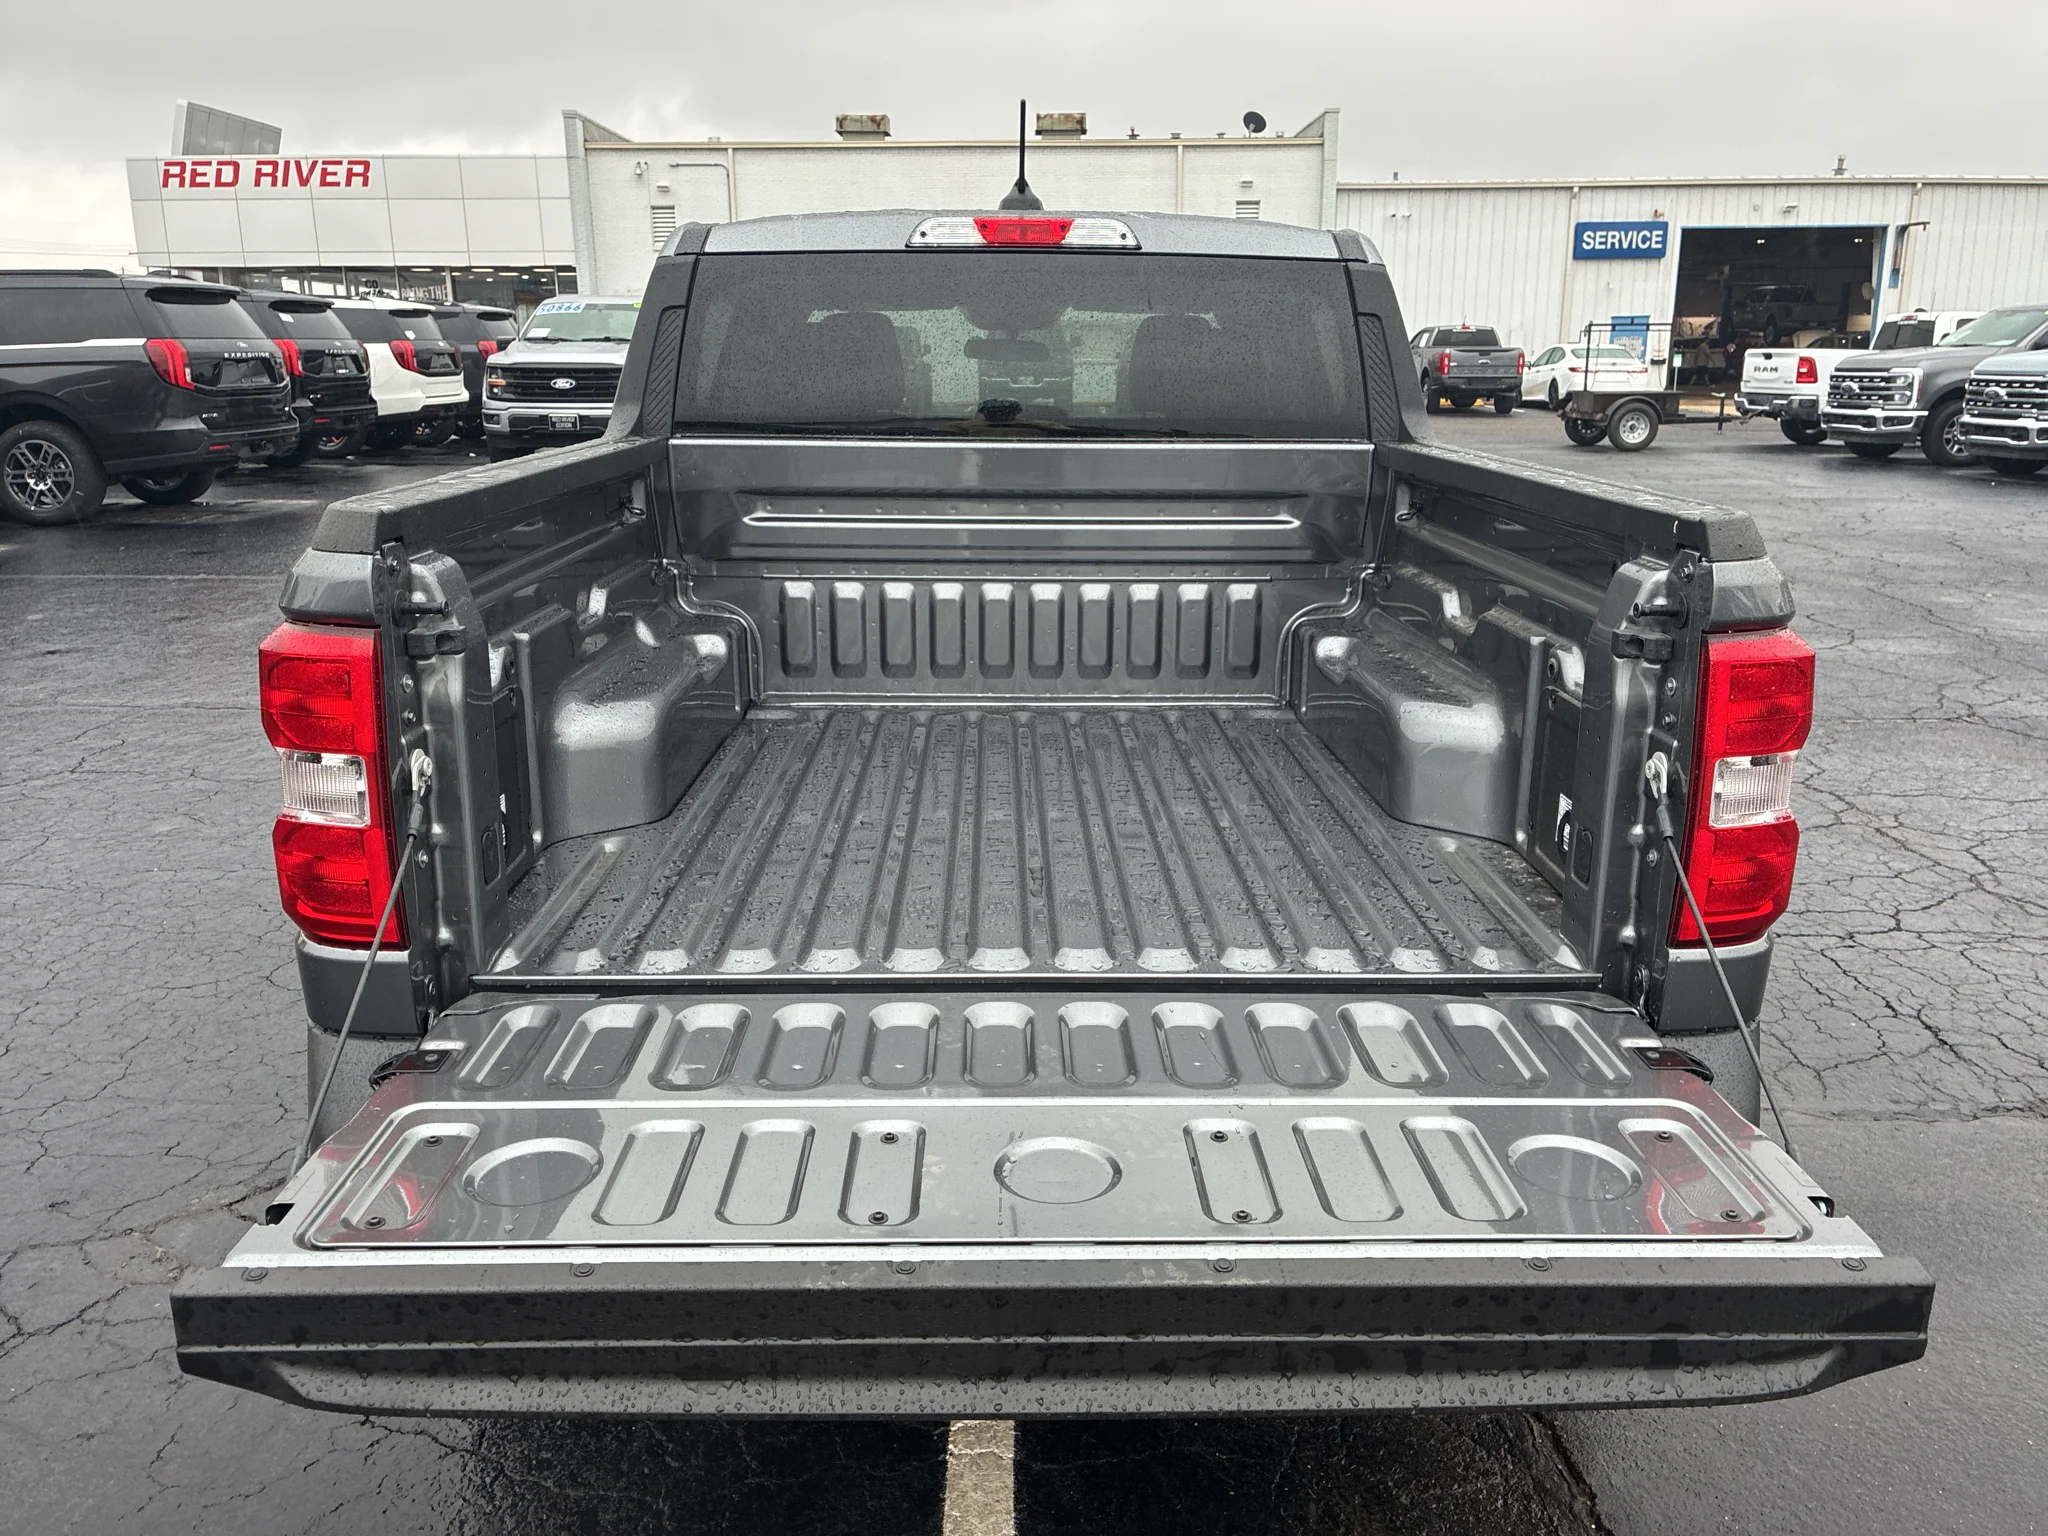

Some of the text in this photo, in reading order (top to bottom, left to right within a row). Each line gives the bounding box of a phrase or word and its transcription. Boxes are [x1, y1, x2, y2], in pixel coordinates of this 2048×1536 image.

[162, 160, 371, 188] RED RIVER
[1582, 230, 1664, 250] SERVICE
[428, 284, 448, 300] THE
[539, 303, 583, 313] 50866
